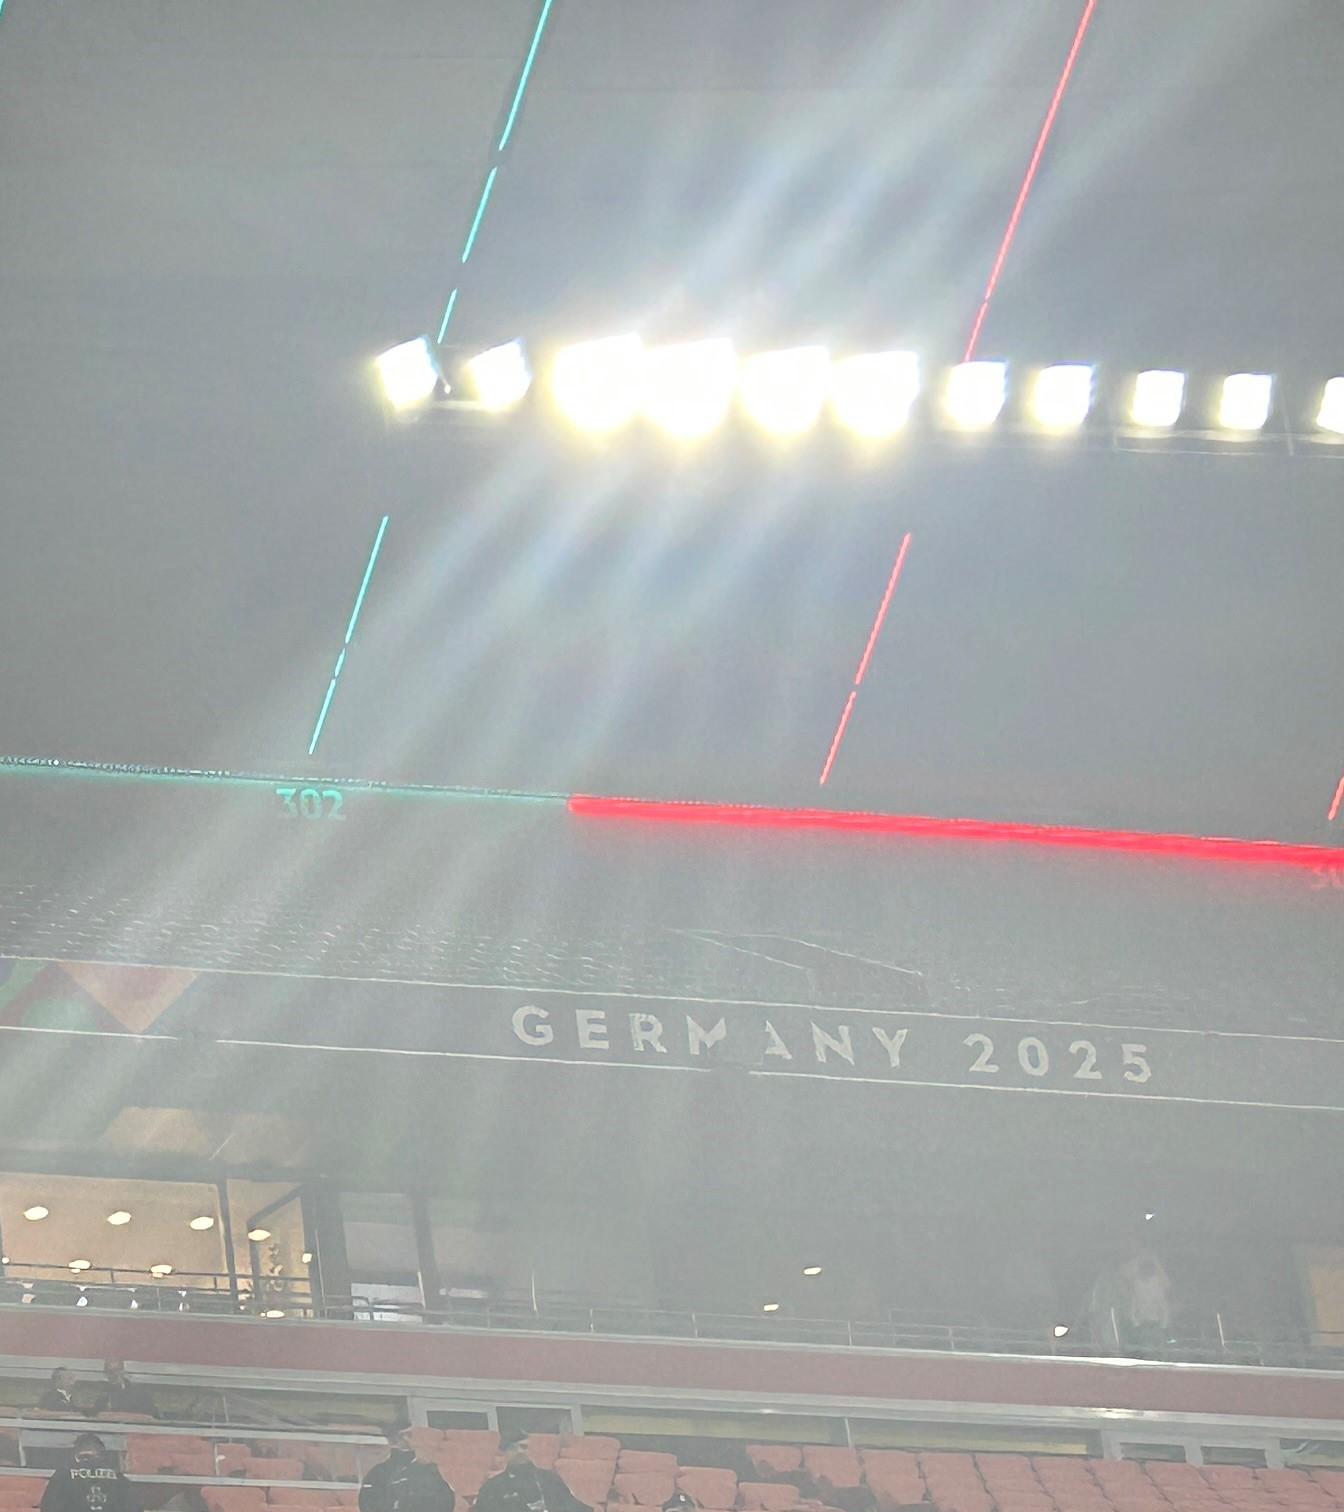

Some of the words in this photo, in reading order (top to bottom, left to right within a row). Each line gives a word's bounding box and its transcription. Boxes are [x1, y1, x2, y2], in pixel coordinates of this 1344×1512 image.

[275, 787, 346, 820] 302
[511, 1005, 909, 1068] GERMANY
[962, 1033, 1152, 1083] 2025
